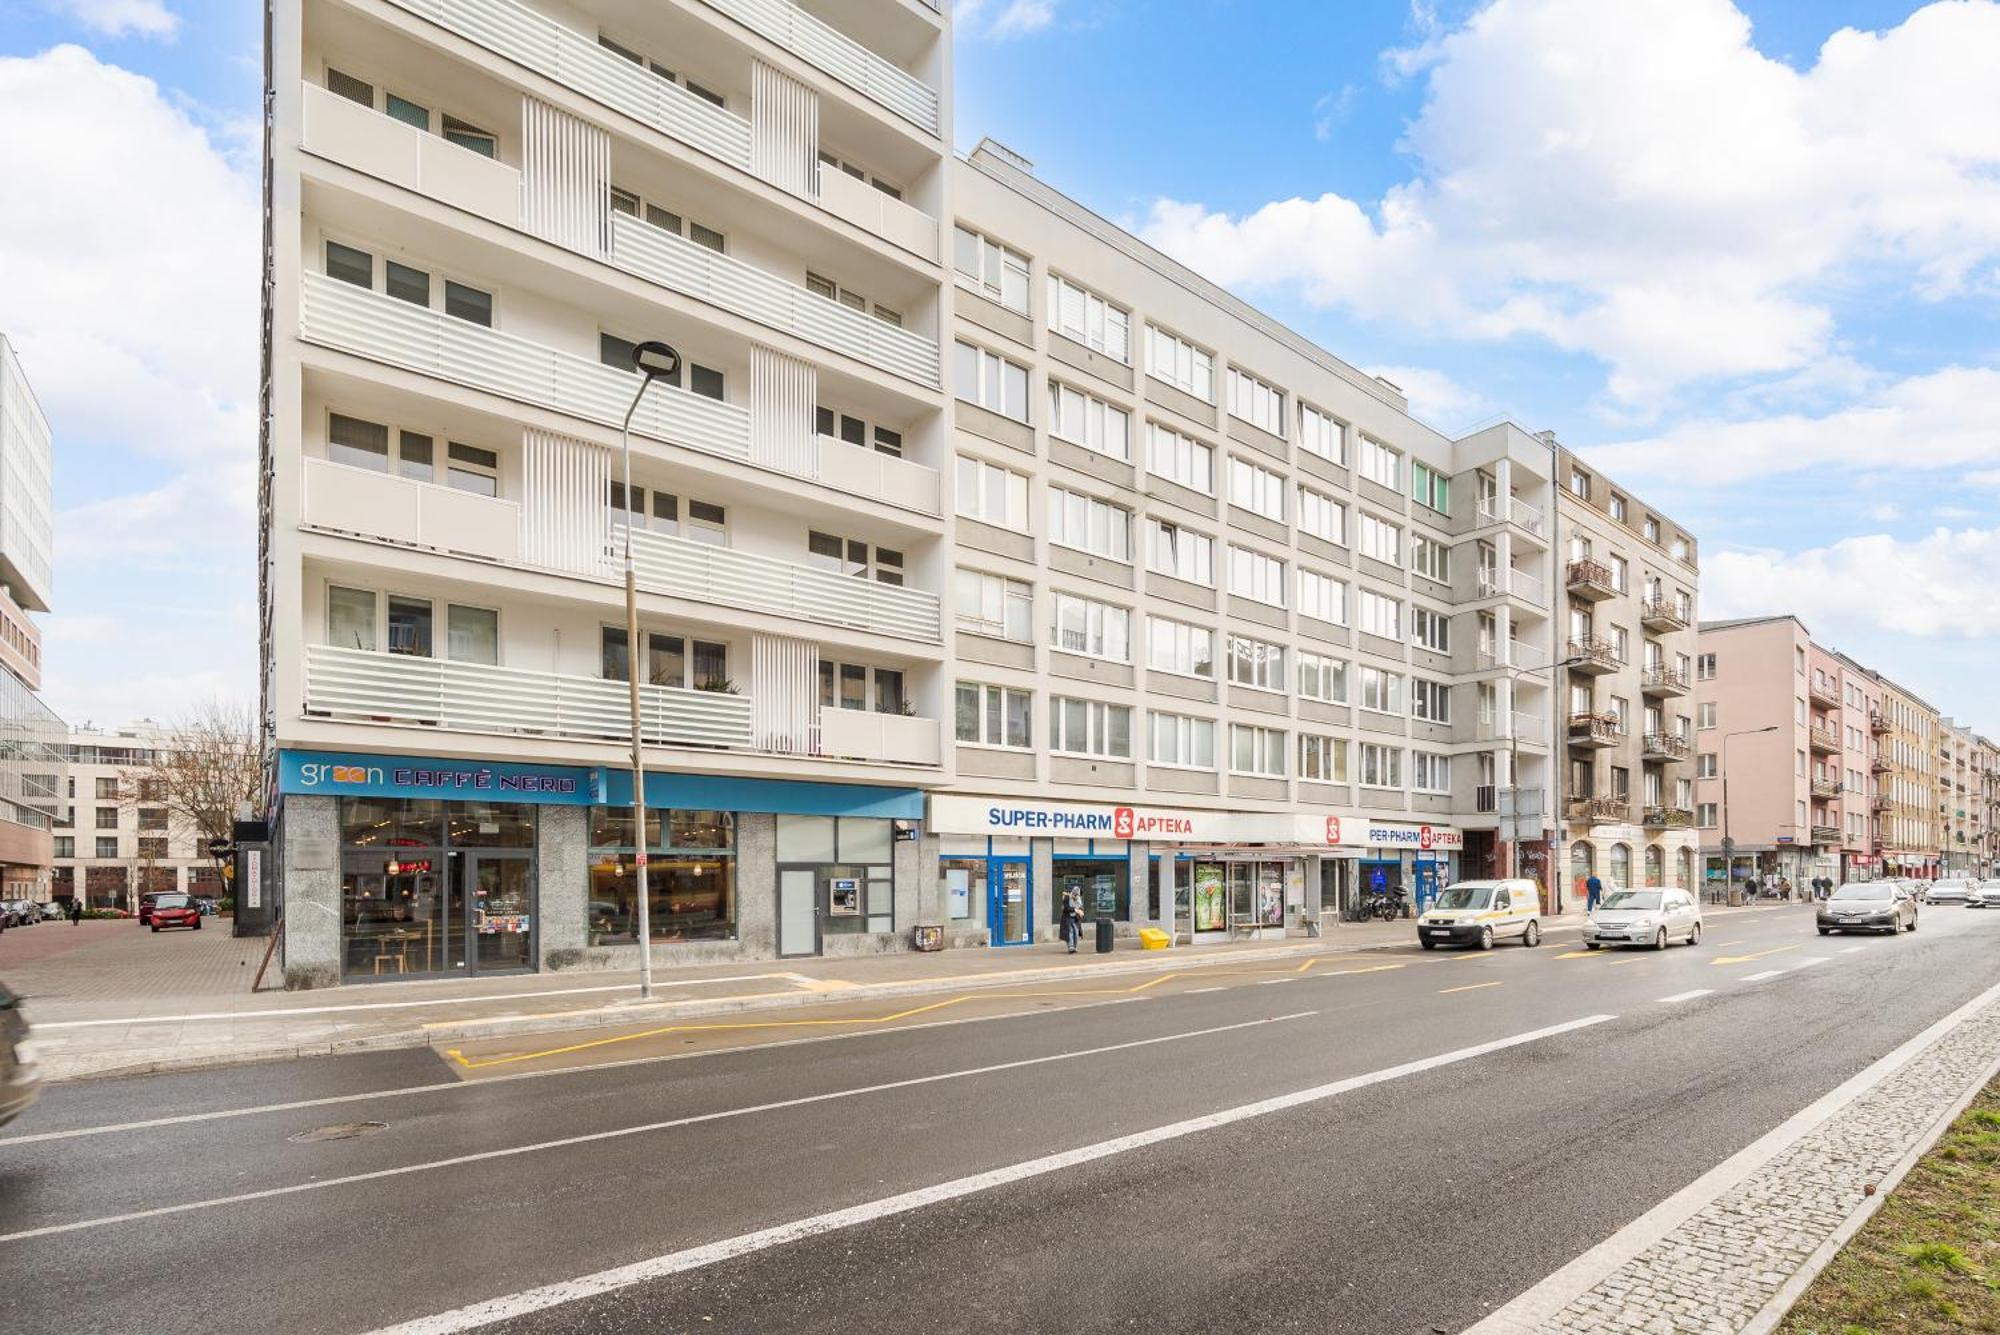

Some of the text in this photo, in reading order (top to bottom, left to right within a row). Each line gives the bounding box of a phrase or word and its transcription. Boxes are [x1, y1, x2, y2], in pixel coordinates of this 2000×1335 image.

[300, 763, 384, 786] green
[499, 774, 577, 793] NERO
[988, 807, 1112, 831] SUPER-PHARM
[1137, 817, 1193, 833] APTEKA
[1431, 832, 1462, 845] APTEKA
